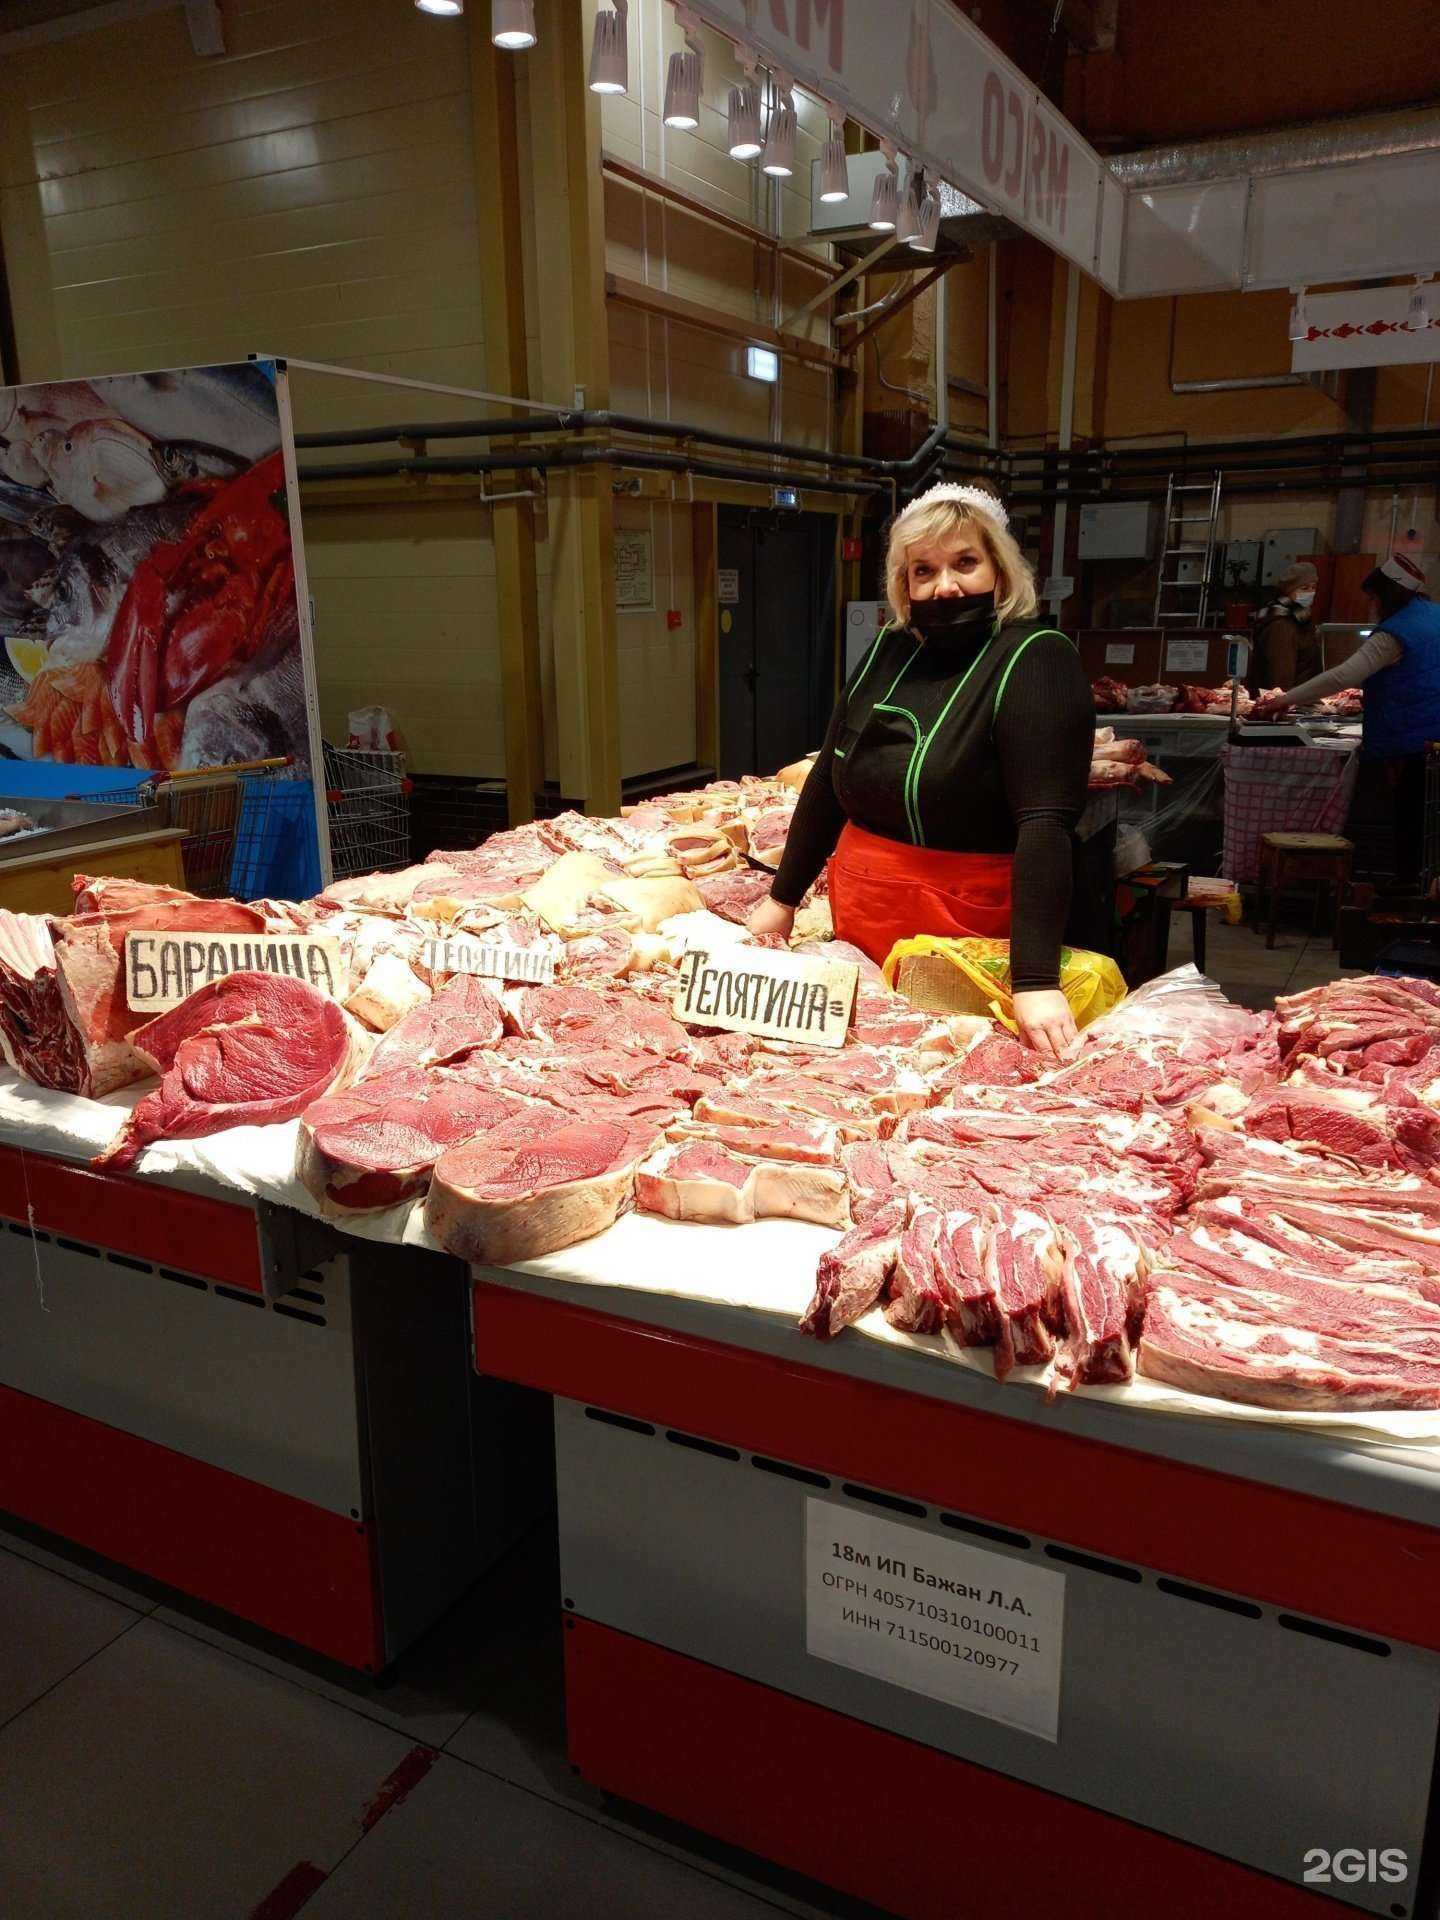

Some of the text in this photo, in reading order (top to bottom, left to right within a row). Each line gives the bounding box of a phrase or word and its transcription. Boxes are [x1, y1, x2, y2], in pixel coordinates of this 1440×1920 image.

[822, 1572, 1041, 1653] ОГРН 405710310100011
[832, 1542, 1032, 1617] 18м ИП Бажан Л.А.
[843, 1607, 1019, 1676] ИНН 711500120977
